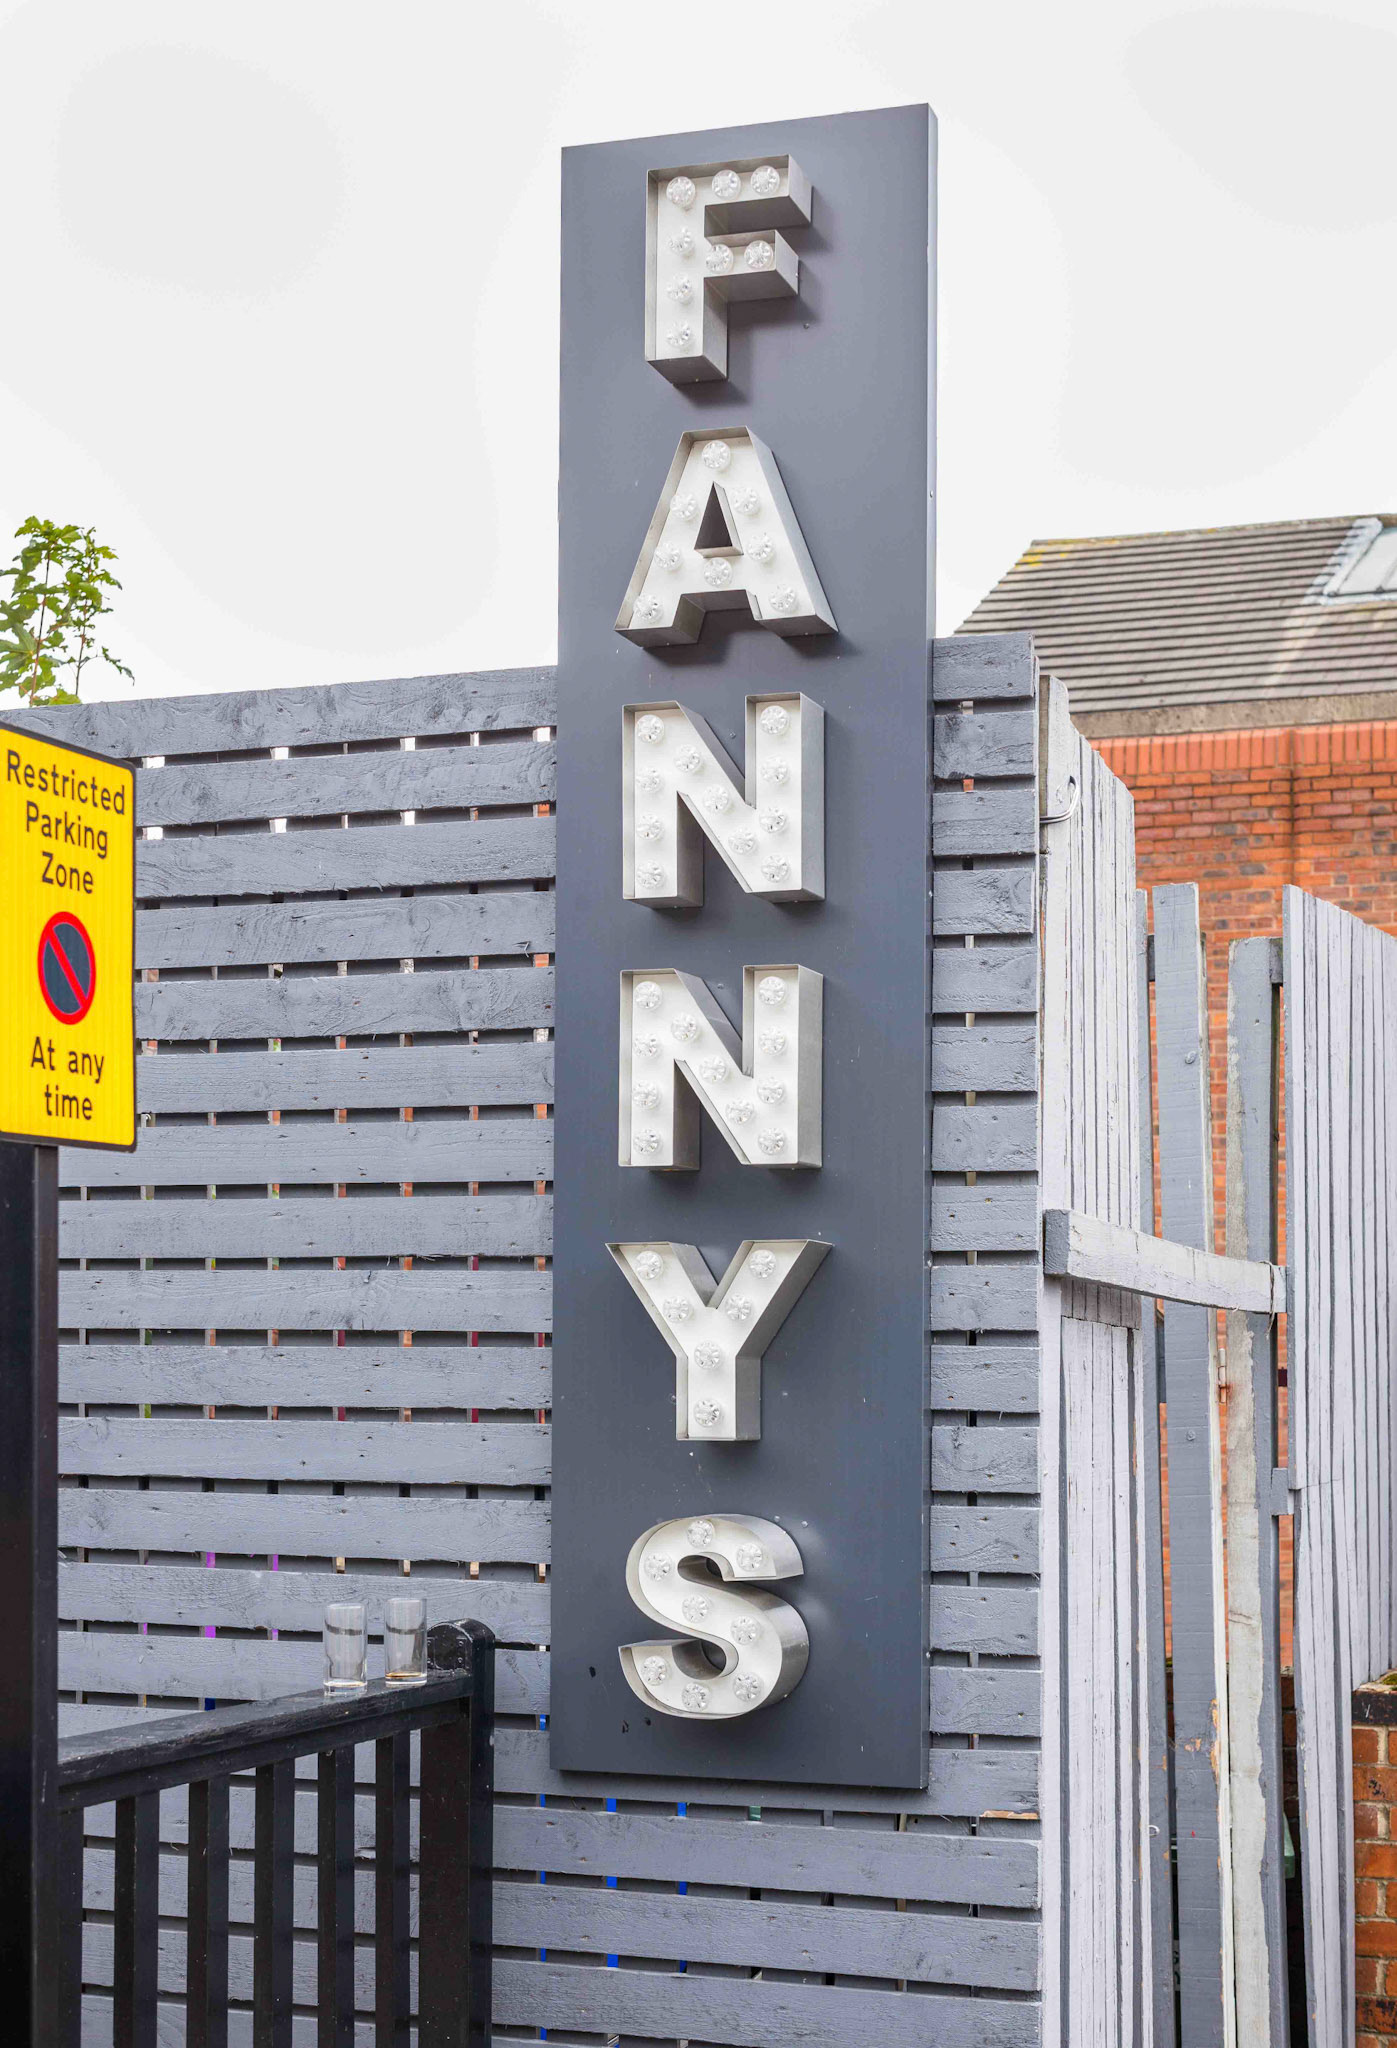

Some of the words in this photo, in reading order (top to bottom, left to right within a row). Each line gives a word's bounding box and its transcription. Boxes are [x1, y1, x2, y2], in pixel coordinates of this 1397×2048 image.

[7, 750, 125, 815] Restricted
[26, 800, 109, 859] Parking
[41, 851, 94, 894] Zone
[605, 156, 834, 1720] FANNYS
[30, 1036, 56, 1070] At
[67, 1049, 105, 1084] any
[44, 1085, 93, 1121] time
